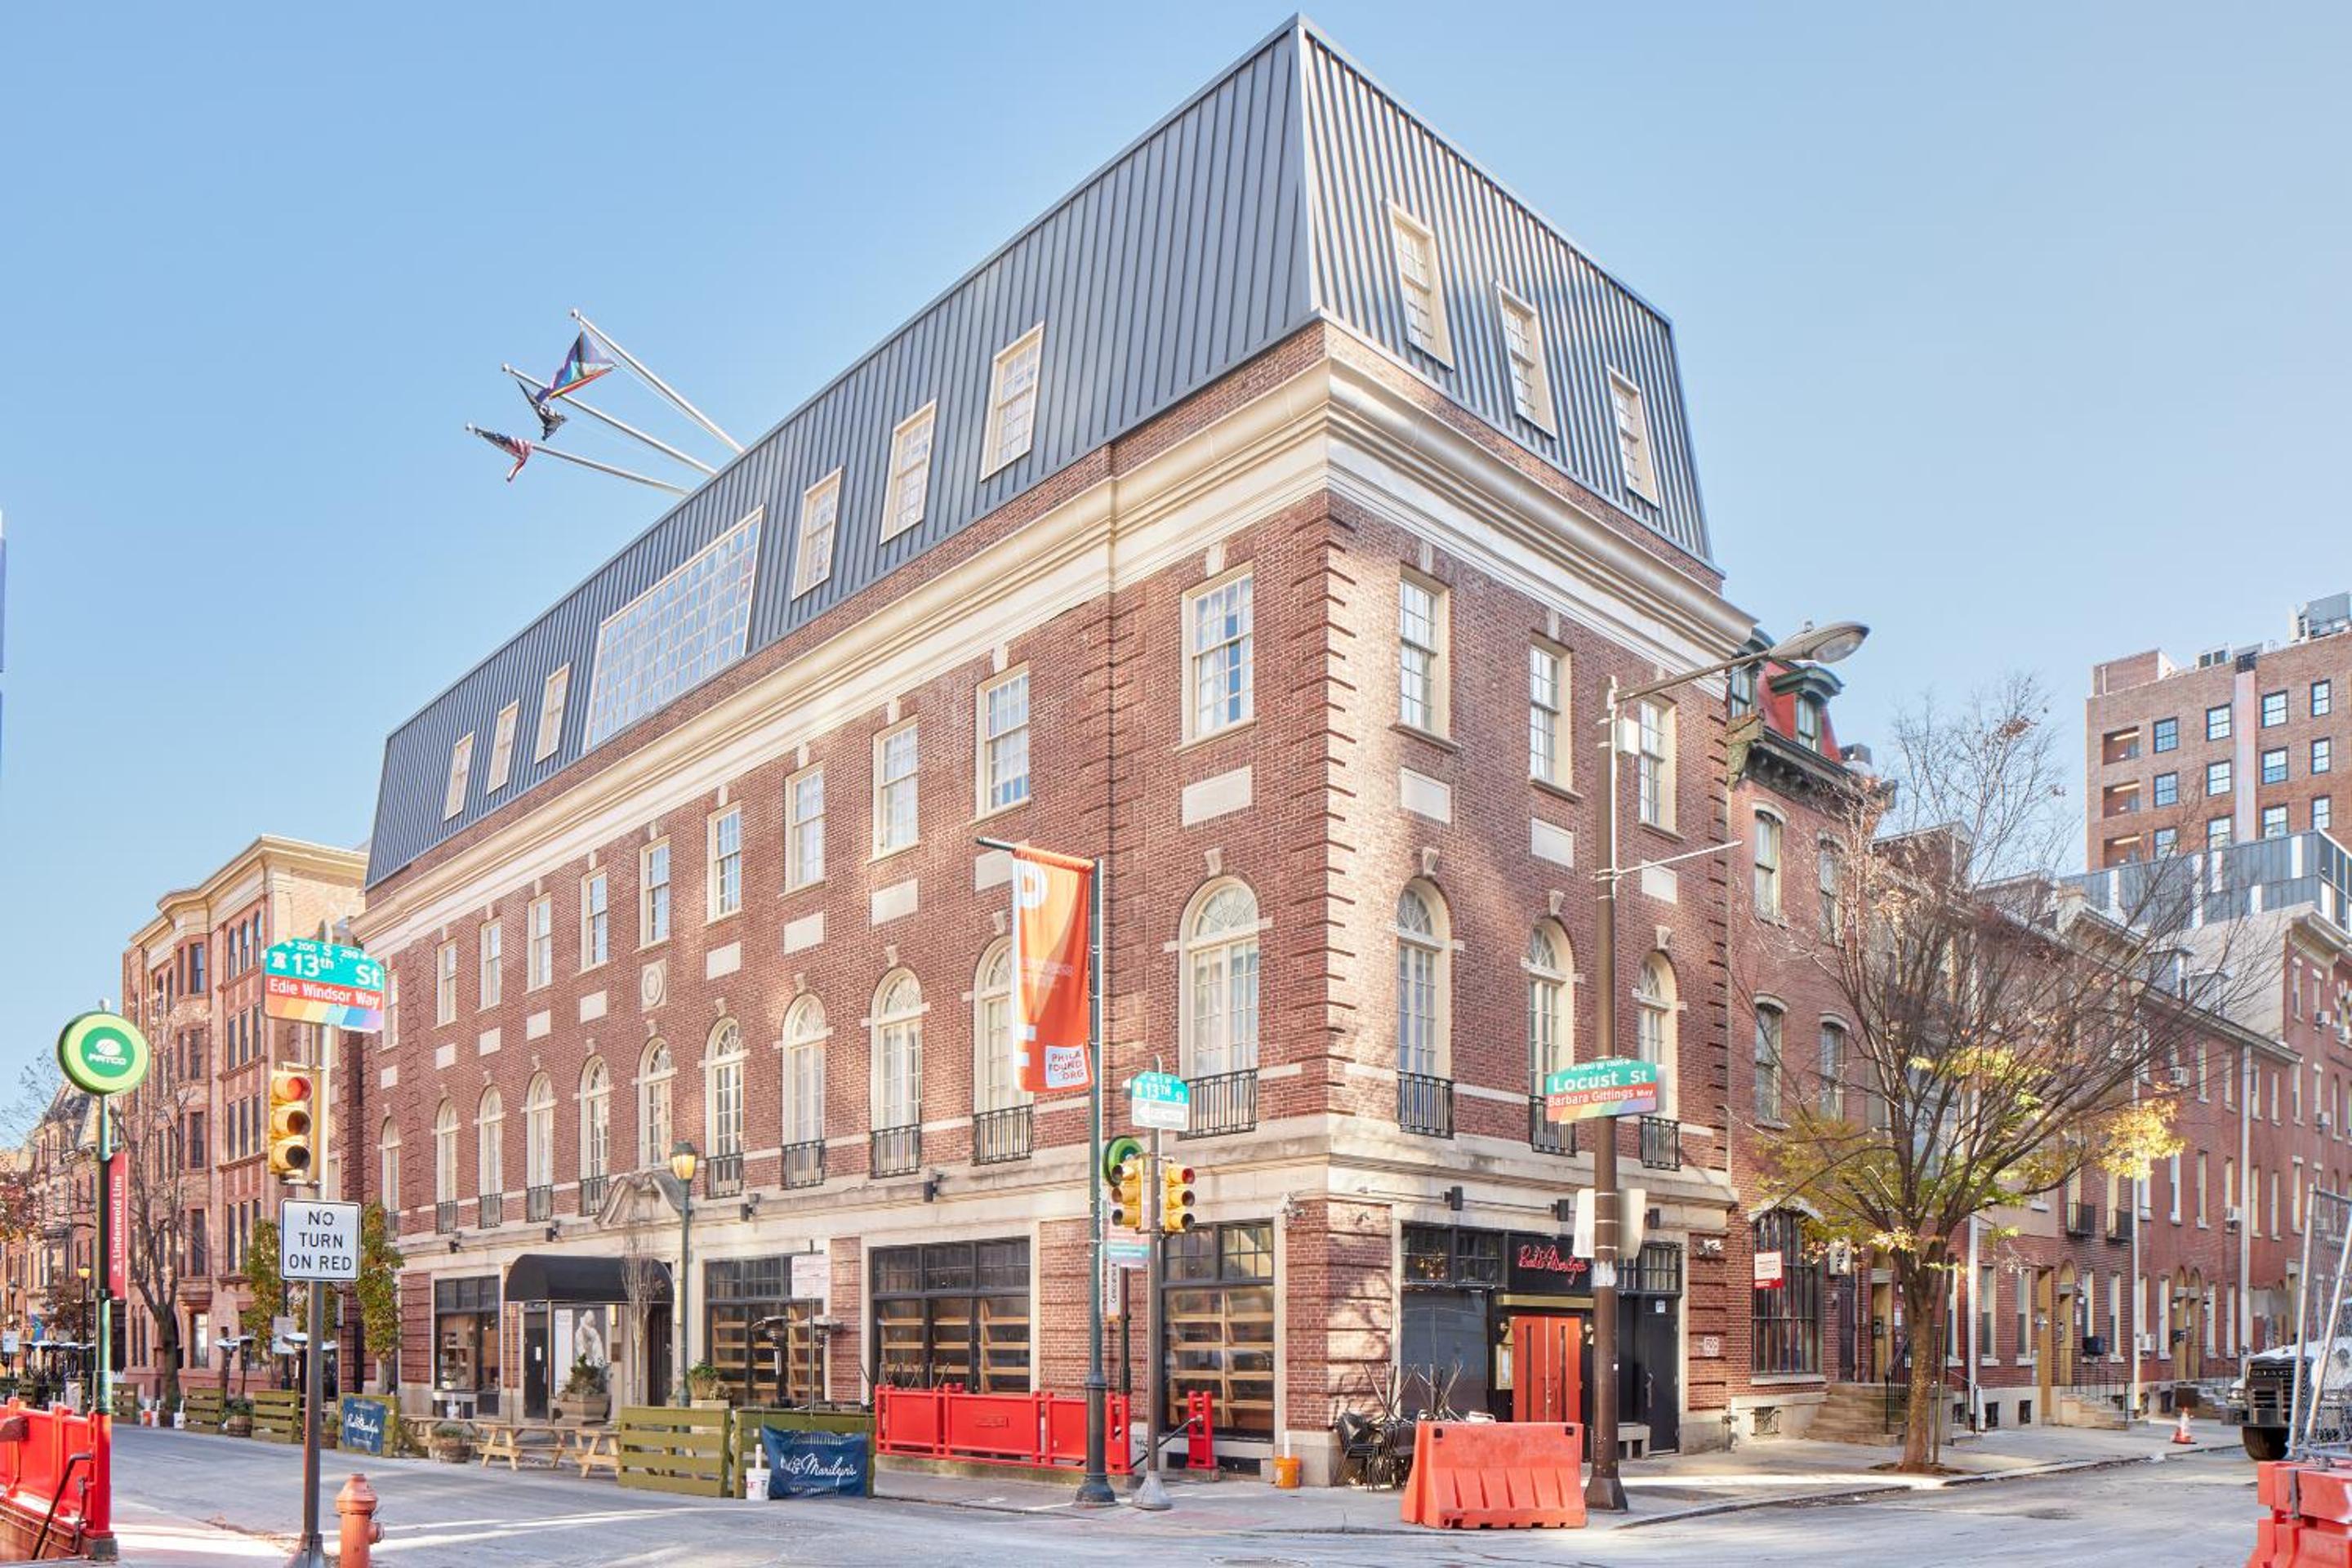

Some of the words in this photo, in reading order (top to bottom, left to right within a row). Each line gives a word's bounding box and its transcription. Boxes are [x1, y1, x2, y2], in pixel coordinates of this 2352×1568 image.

[292, 952, 334, 978] 13th
[355, 964, 381, 988] St
[270, 978, 298, 995] Edie
[302, 982, 351, 1003] Windsor
[355, 991, 381, 1010] Way
[1051, 1050, 1081, 1062] PHILA
[1553, 1071, 1619, 1093] Locust
[1629, 1070, 1647, 1084] St
[1548, 1094, 1589, 1107] Barbara
[1592, 1088, 1634, 1102] Gittings
[113, 1175, 122, 1197] Line
[113, 1200, 122, 1258] Lindenwold
[308, 1211, 334, 1227] NO
[299, 1232, 343, 1249] TURN
[289, 1254, 311, 1269] ON
[319, 1255, 352, 1272] RED
[800, 1453, 857, 1486] Marilyn's
